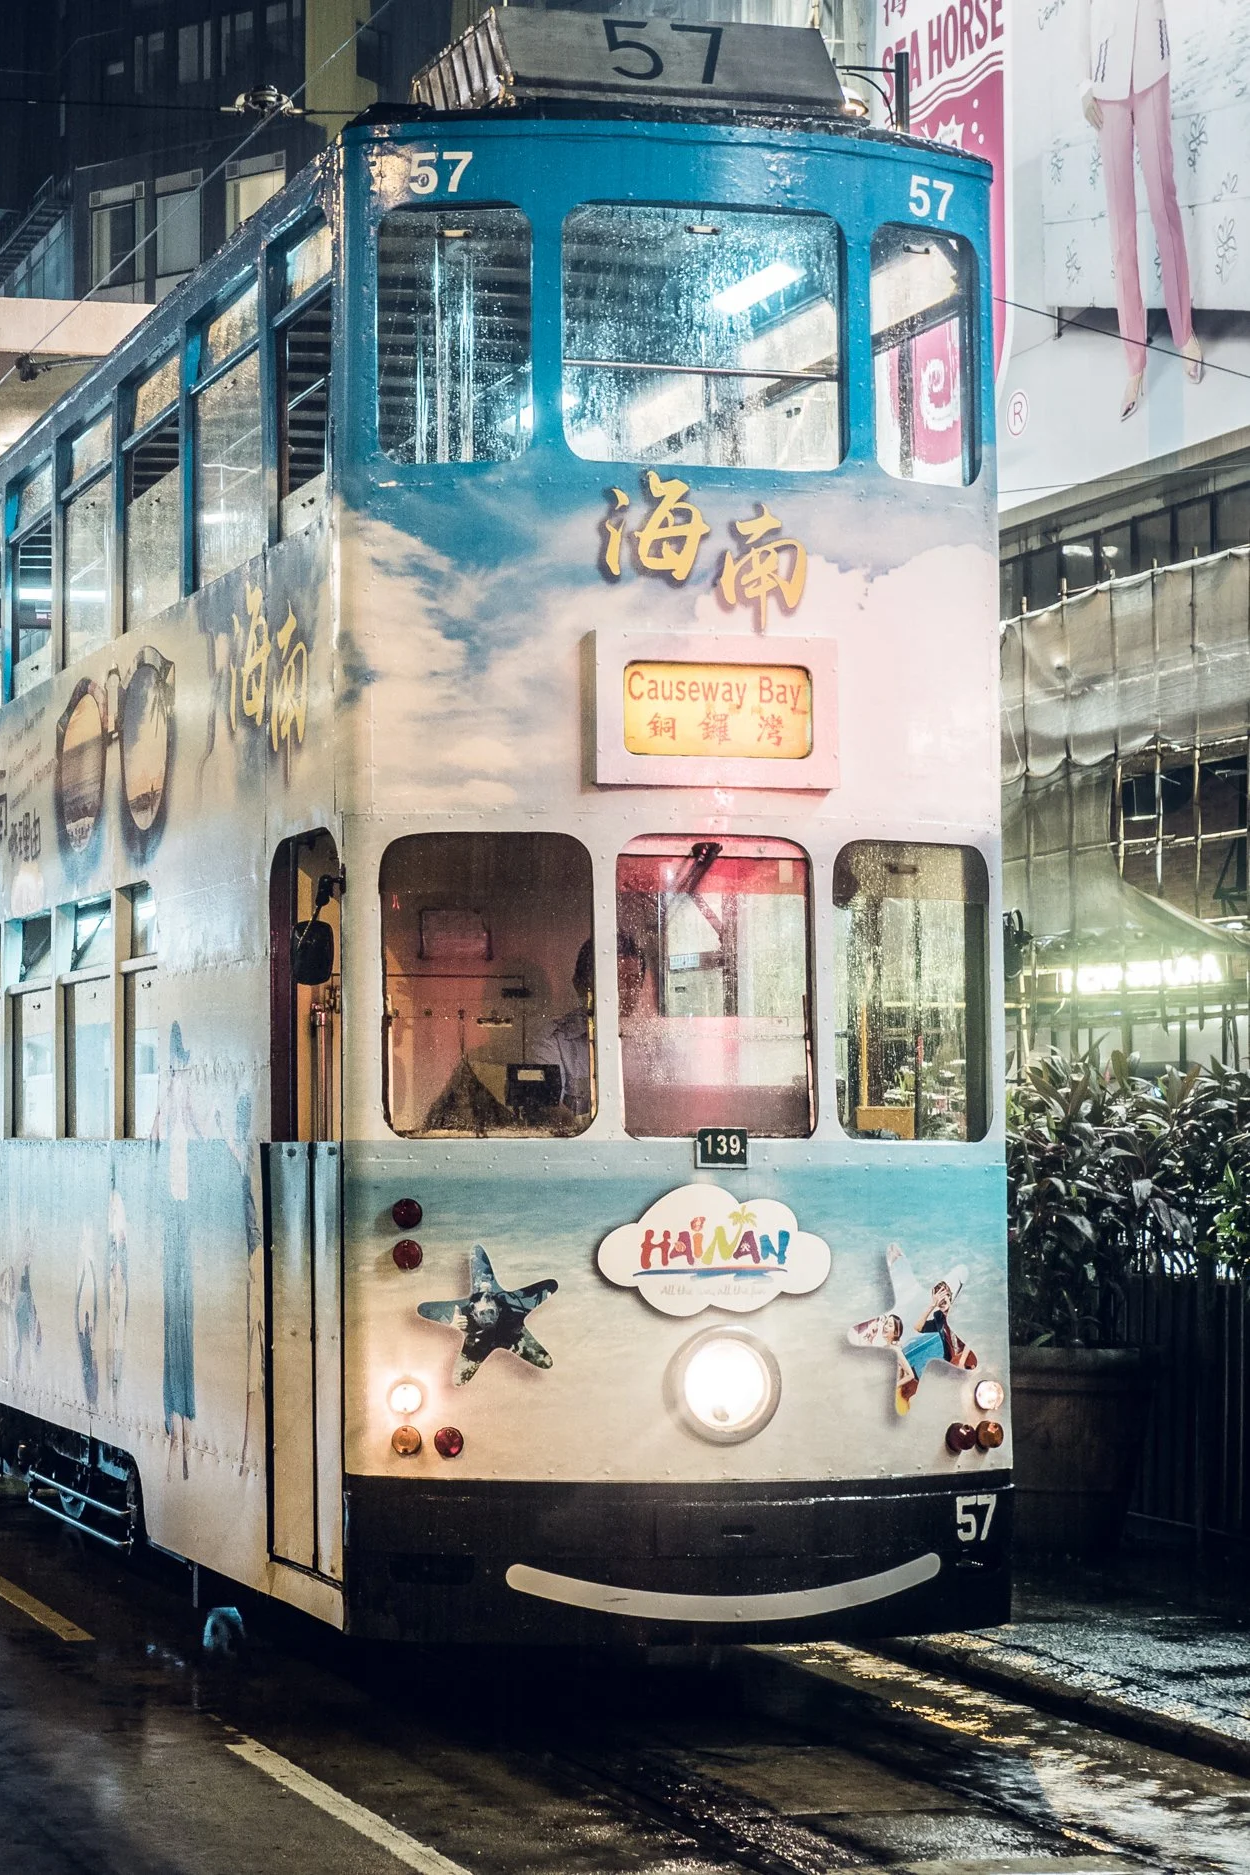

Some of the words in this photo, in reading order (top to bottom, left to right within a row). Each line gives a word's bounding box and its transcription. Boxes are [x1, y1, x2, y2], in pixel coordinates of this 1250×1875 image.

[602, 19, 723, 84] 57
[882, 29, 922, 108] SA
[928, 0, 1004, 81] HORSE
[409, 151, 473, 194] 57
[908, 174, 954, 221] 57
[605, 470, 808, 630] 海南
[627, 670, 747, 709] Causeway
[758, 675, 803, 712] Bay
[647, 711, 784, 747] 銅鑼灣
[956, 1494, 997, 1542] 57
